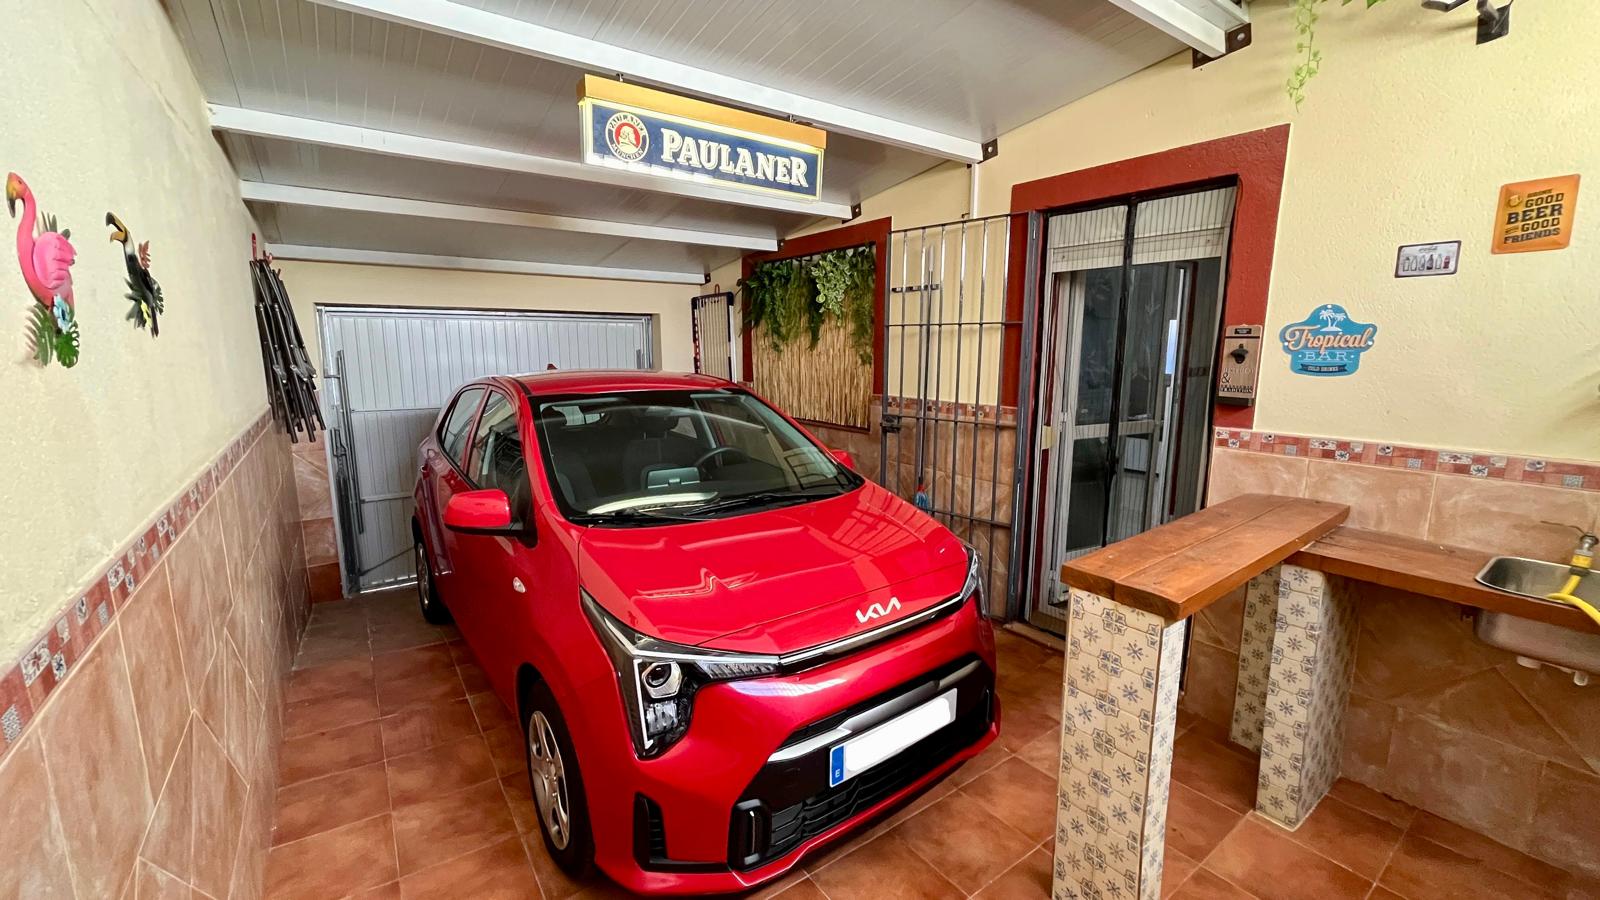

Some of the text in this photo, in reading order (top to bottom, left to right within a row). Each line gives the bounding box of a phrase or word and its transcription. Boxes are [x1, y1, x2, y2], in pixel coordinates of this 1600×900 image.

[660, 128, 809, 188] PAULANER
[1525, 192, 1564, 208] GOOD
[1506, 203, 1563, 225] BEER
[1521, 217, 1560, 232] GOOD
[1504, 227, 1561, 244] FRIENDS
[1285, 325, 1373, 355] Tropical
[1303, 351, 1348, 361] BAR
[1221, 372, 1231, 383] &
[855, 596, 902, 623] KIA
[835, 768, 841, 778] E
